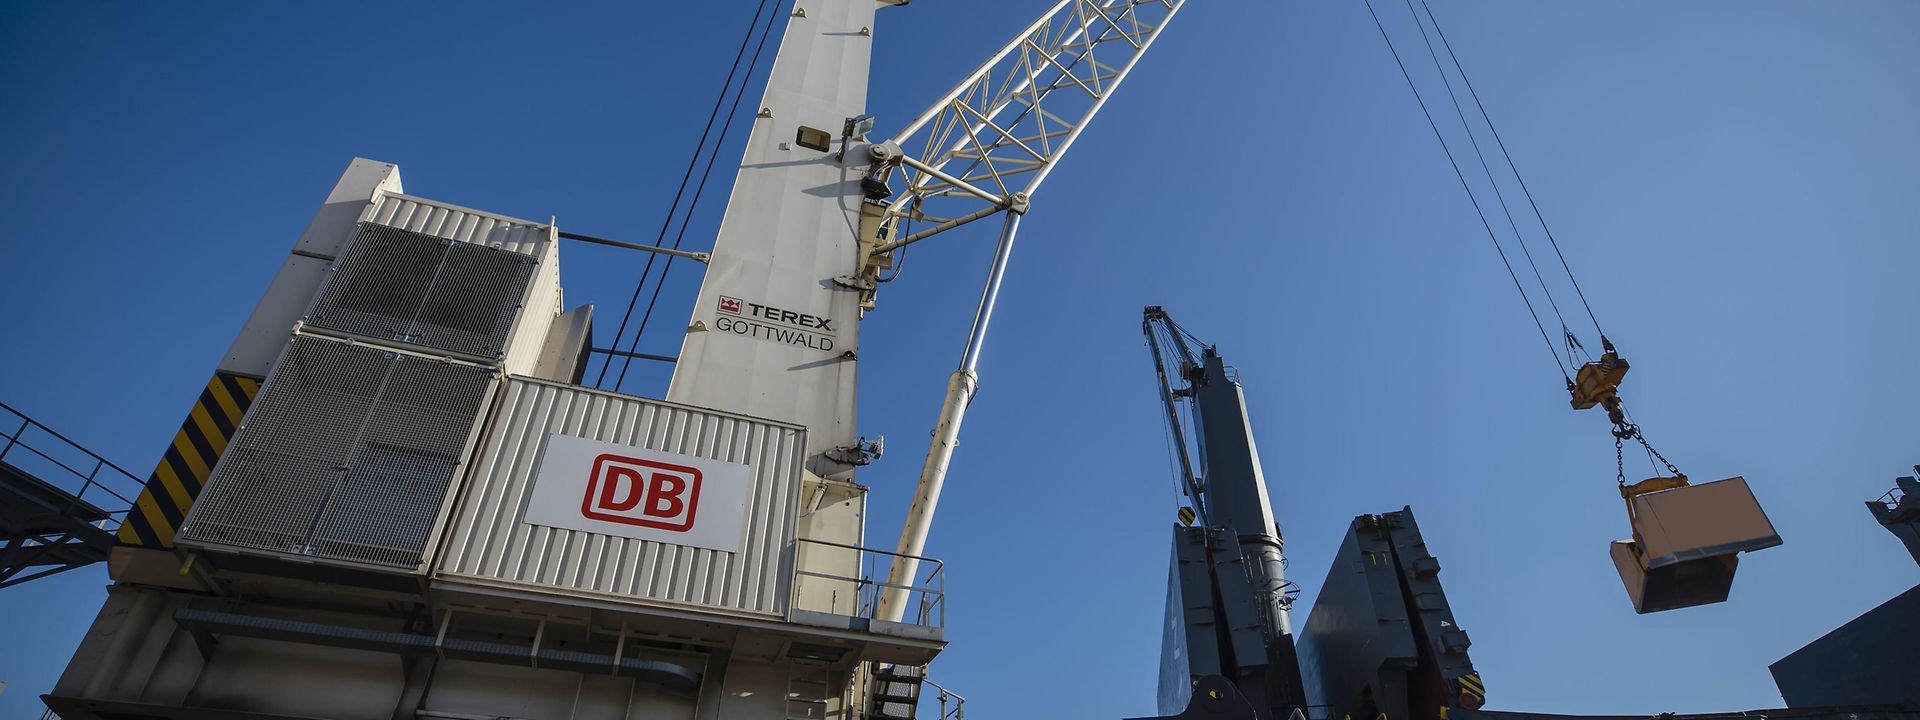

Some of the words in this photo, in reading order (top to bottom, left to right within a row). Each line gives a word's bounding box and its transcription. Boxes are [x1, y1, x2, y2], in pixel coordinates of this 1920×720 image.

[716, 317, 833, 351] GOTTWALD
[748, 302, 832, 332] TEREX
[597, 465, 686, 518] DB
